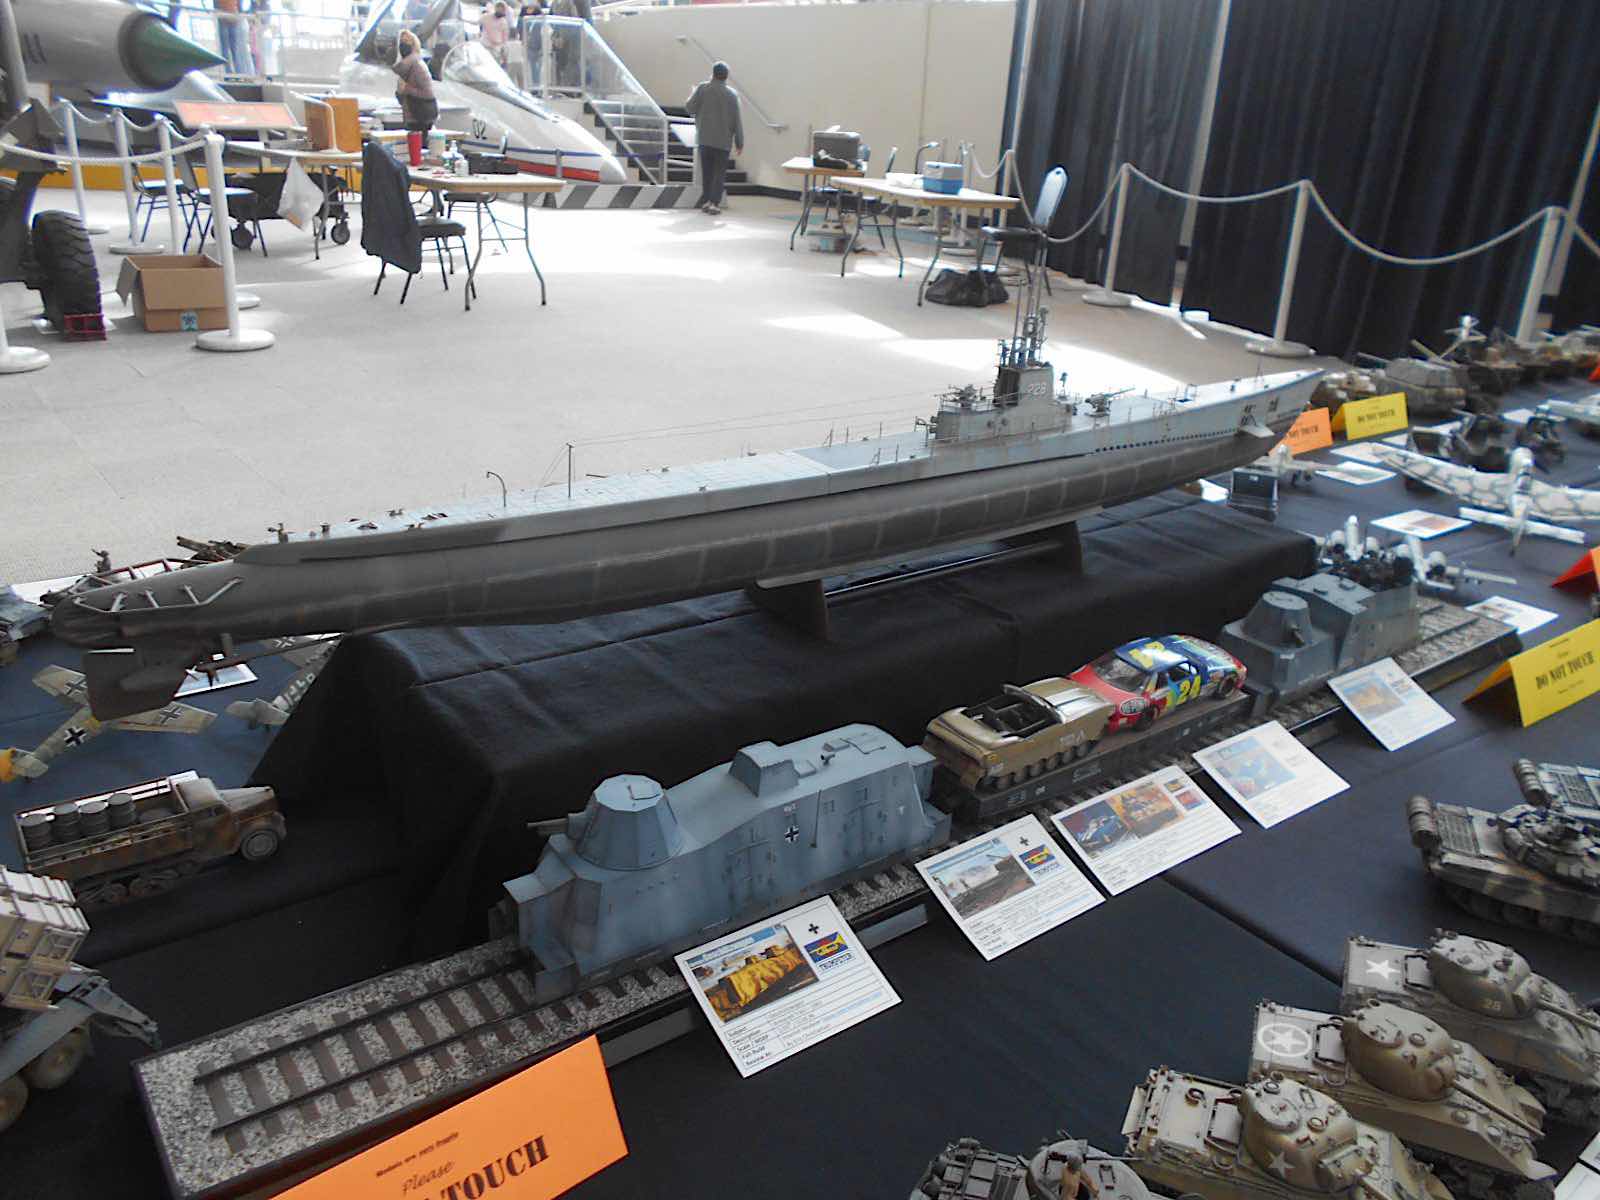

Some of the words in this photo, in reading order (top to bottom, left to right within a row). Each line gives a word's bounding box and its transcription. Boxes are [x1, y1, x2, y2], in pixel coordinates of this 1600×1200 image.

[1301, 424, 1320, 434] TOUCH
[1378, 408, 1397, 419] TOUCH
[1535, 673, 1549, 691] DO
[1549, 663, 1567, 682] NOT
[1567, 650, 1595, 674] TOUCH
[1176, 674, 1201, 706] 24
[401, 1160, 455, 1198] Please
[440, 1135, 550, 1200] TOUCH
